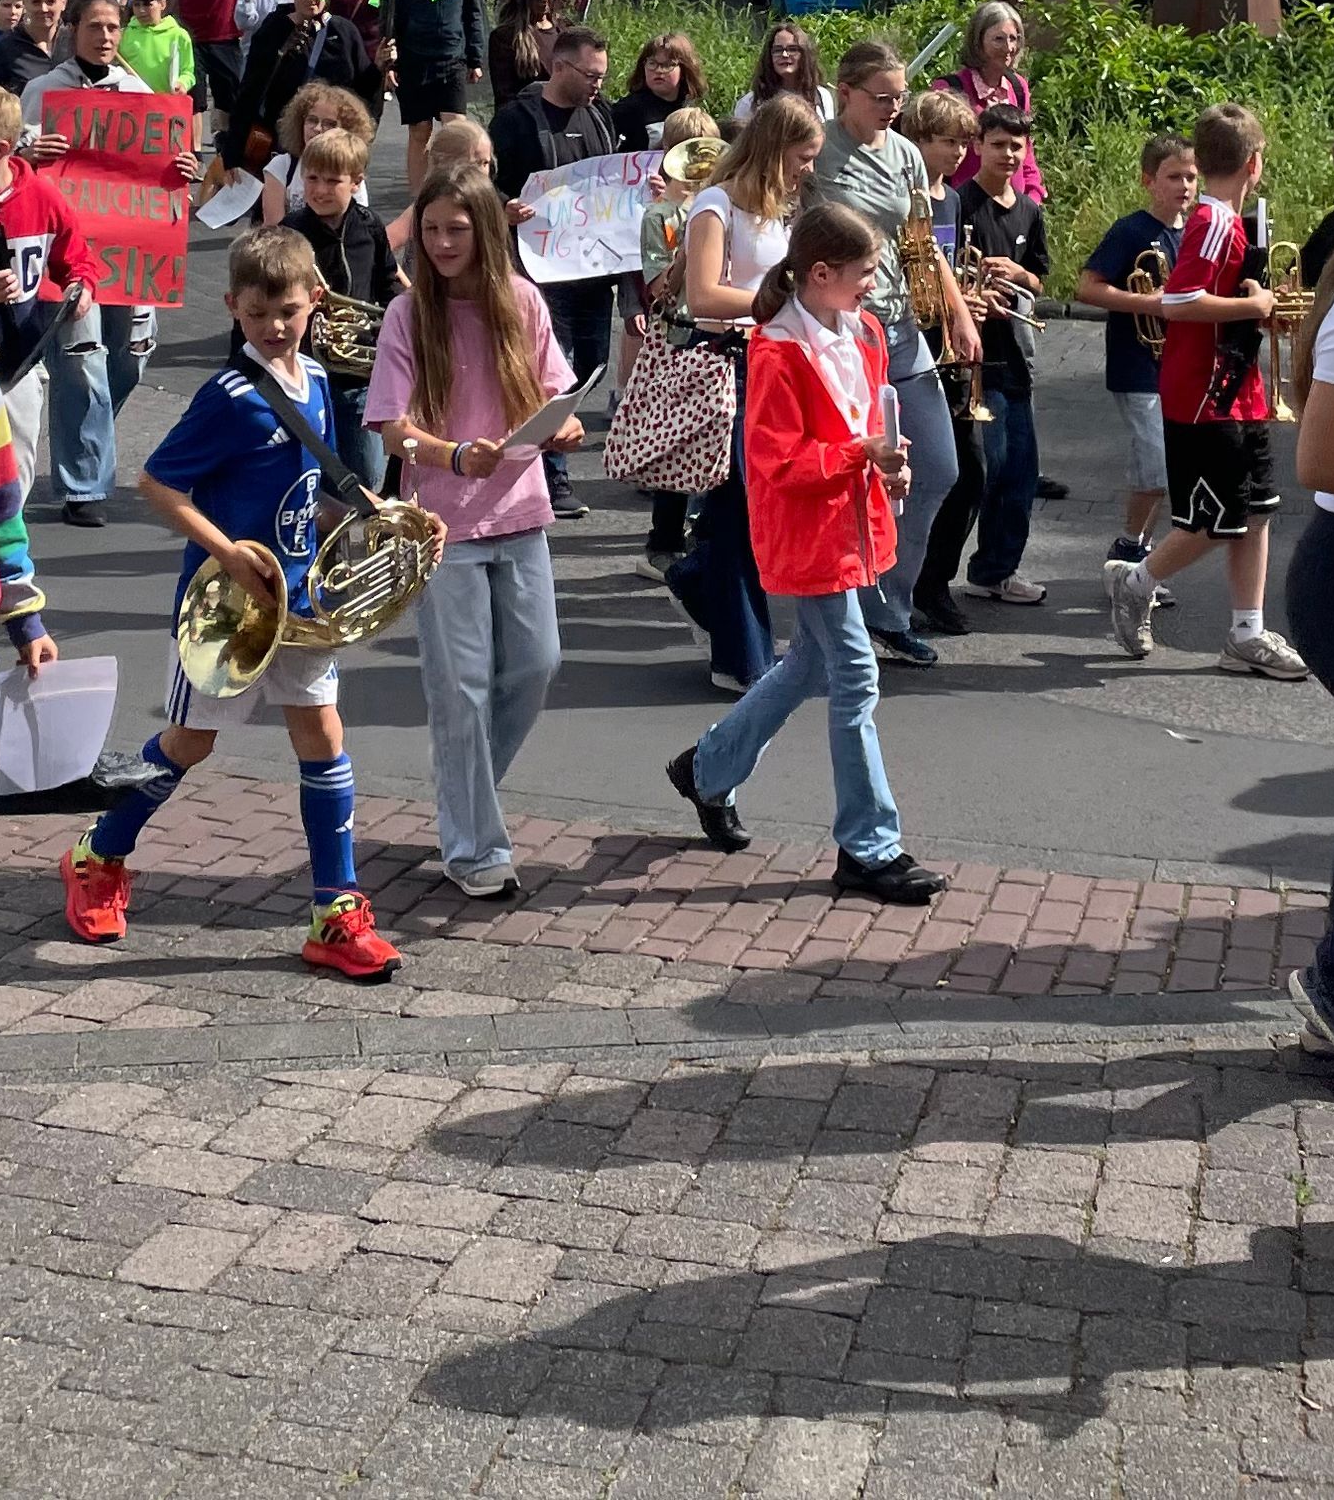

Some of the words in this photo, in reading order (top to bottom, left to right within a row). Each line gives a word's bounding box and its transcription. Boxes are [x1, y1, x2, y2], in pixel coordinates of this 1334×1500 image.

[44, 106, 187, 154] KINDER
[622, 151, 664, 186] IST
[47, 176, 184, 220] RAUCHEN
[547, 195, 589, 229] UNS
[533, 230, 571, 261] TIG
[281, 500, 319, 526] BAY
